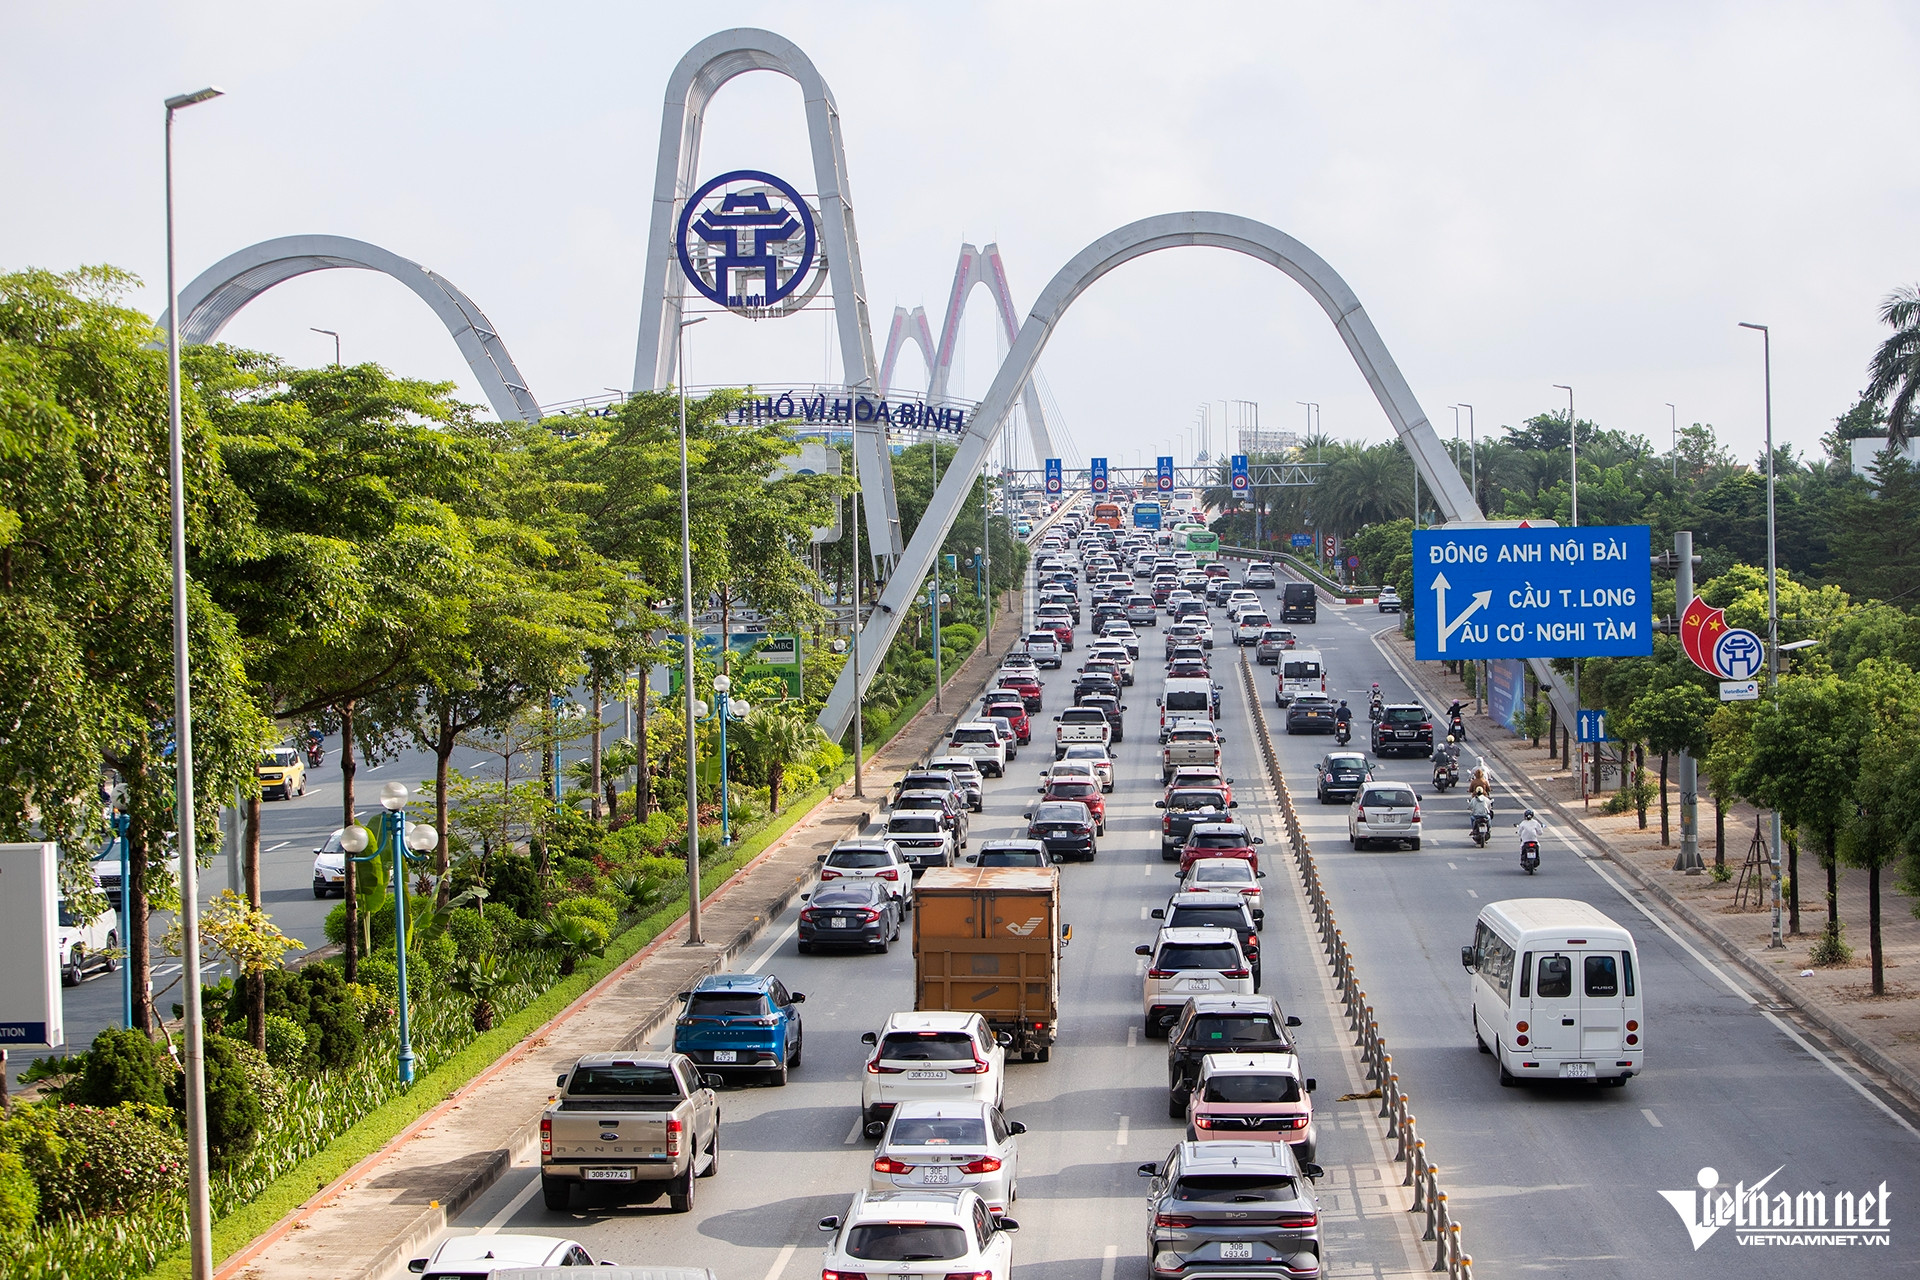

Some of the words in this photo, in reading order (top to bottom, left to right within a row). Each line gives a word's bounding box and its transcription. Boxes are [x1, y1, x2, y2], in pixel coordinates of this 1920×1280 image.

[728, 293, 743, 307] HÀ
[746, 293, 765, 309] NỘI
[801, 394, 827, 422] VÌ
[833, 396, 891, 424] HÒA
[900, 401, 964, 434] BÌNH
[1430, 541, 1488, 564] ĐÔNG
[1497, 544, 1541, 563] ANH
[1550, 539, 1584, 566] NỘI
[1593, 538, 1627, 561] BÀI
[1509, 581, 1550, 609] CẦU
[1460, 621, 1488, 644] ÂU
[1593, 617, 1636, 641] TÀM
[769, 642, 792, 650] SMBC
[773, 670, 795, 678] Nam
[0, 1027, 25, 1037] TION
[1223, 1250, 1249, 1258] 493.48
